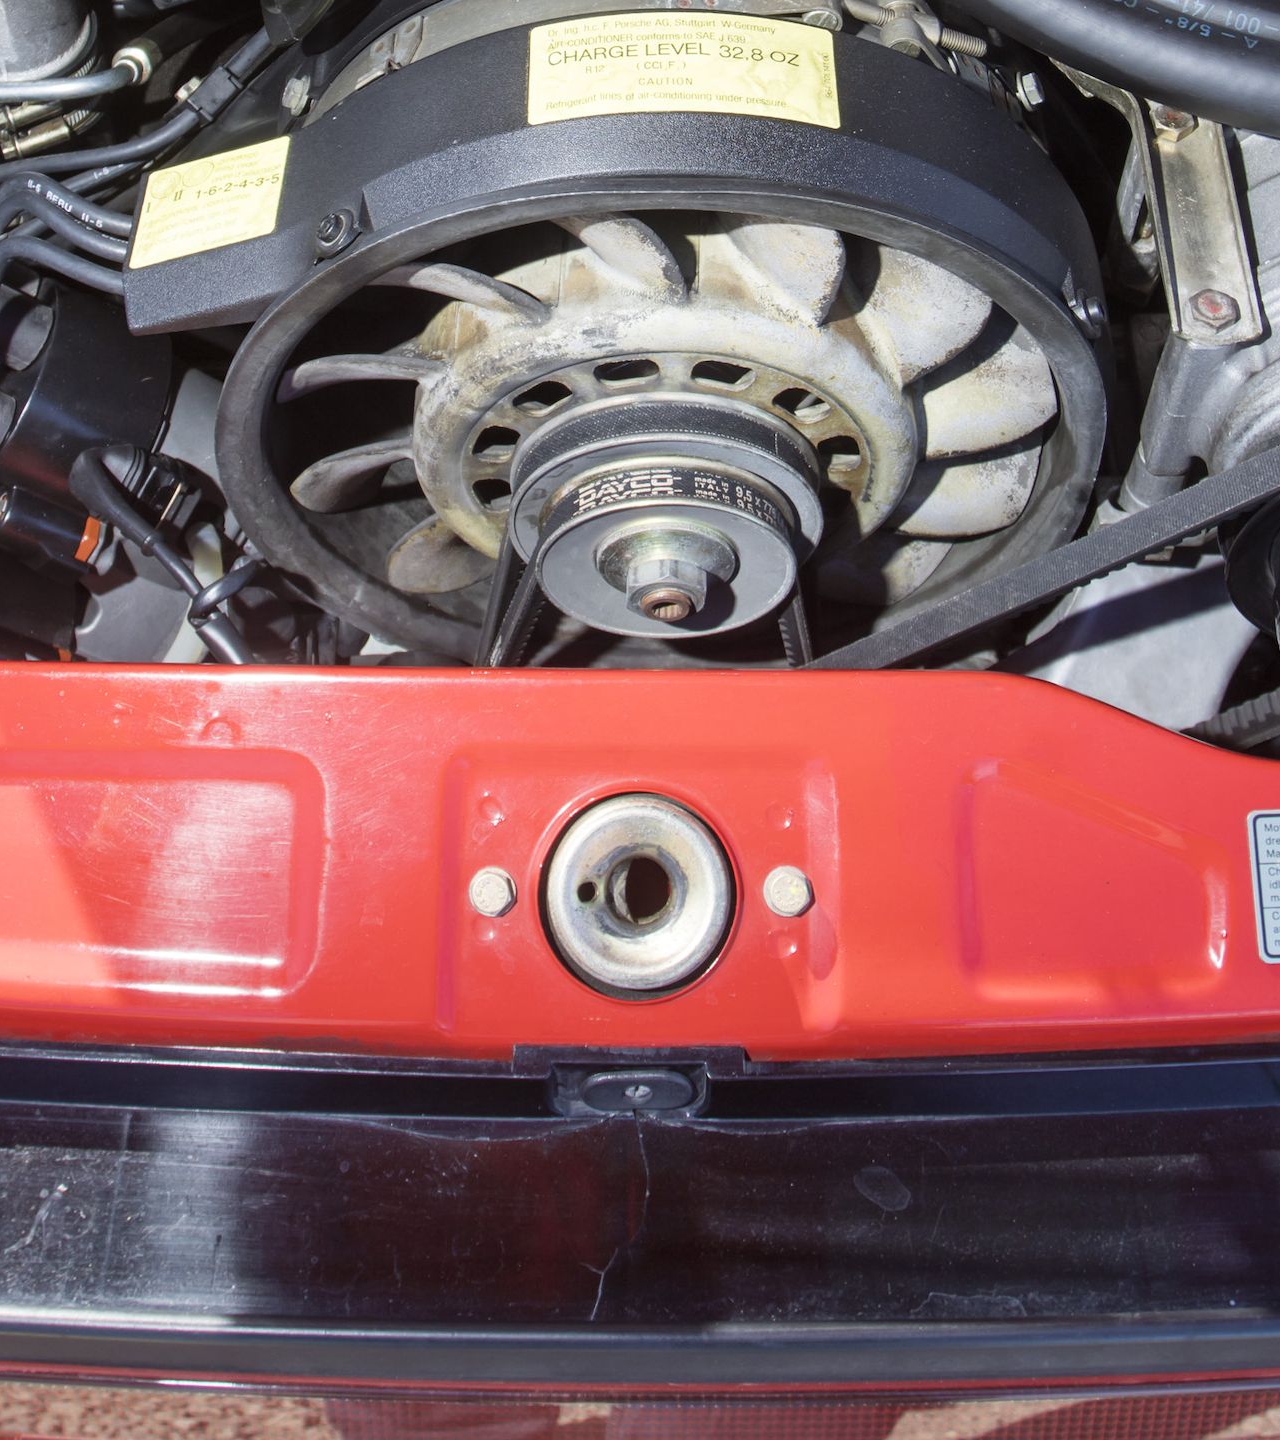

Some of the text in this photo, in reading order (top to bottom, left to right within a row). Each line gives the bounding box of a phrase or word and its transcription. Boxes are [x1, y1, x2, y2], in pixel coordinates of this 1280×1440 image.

[615, 20, 651, 28] Porsche
[636, 33, 680, 41] conforms
[695, 32, 715, 40] SAE
[547, 42, 800, 67] CHARGE LEVEL OZ
[638, 77, 693, 86] CAUTION
[195, 173, 280, 199] 1-6-2-4-3-5
[45, 190, 73, 213] BERU
[578, 473, 674, 505] DAYCO
